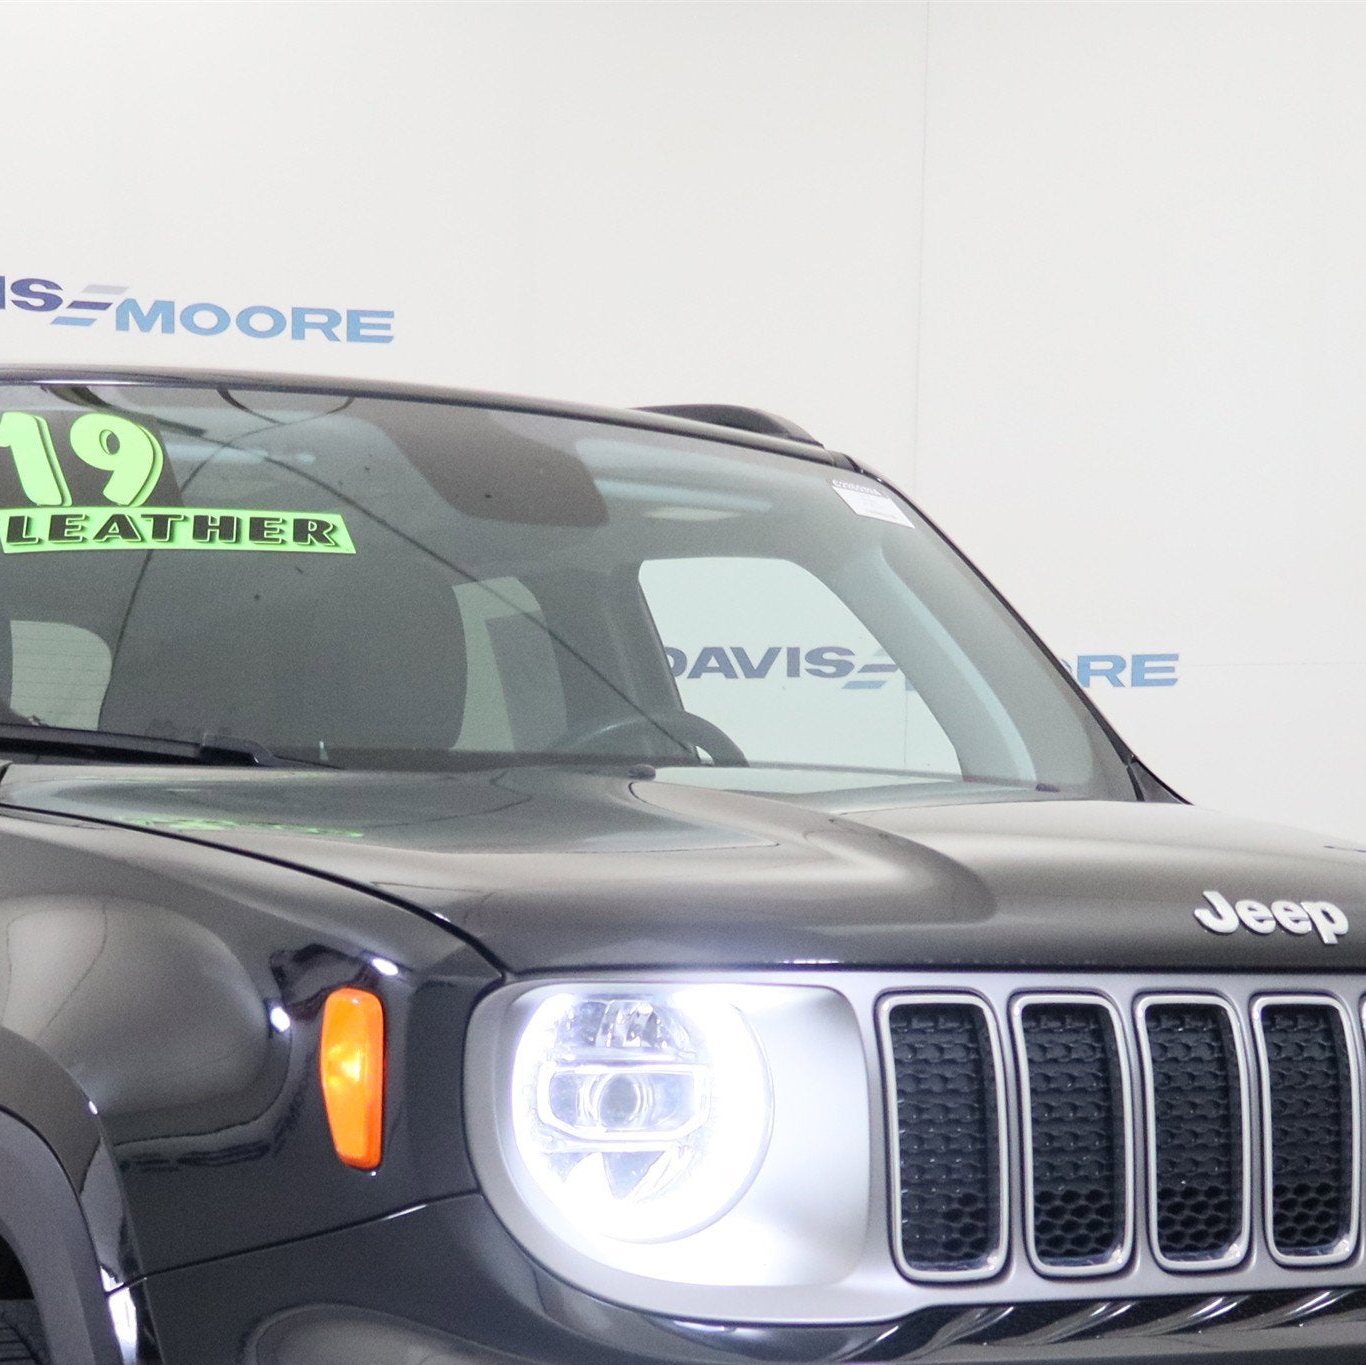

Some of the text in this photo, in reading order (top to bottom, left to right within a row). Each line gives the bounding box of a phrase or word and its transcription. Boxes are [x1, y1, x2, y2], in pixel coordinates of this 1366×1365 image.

[115, 297, 395, 345] MOORE
[4, 512, 339, 548] LEATHER
[1193, 890, 1350, 945] Jeep
